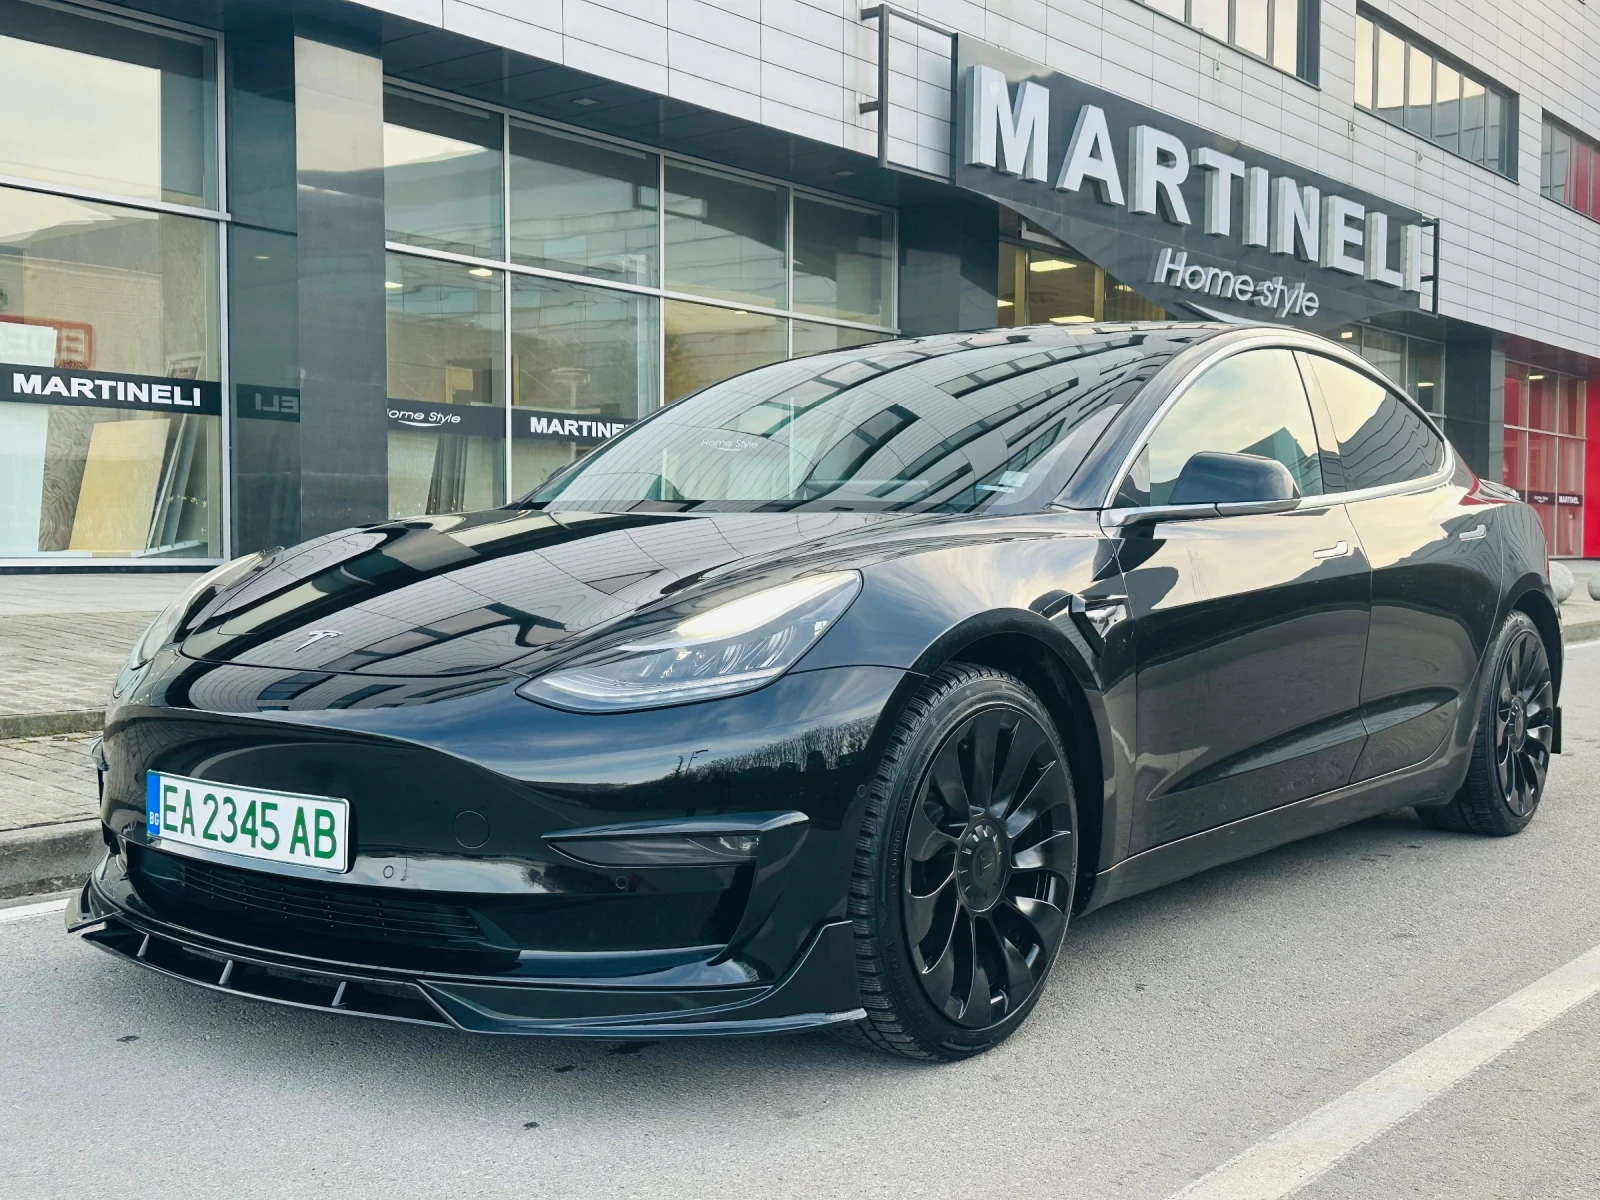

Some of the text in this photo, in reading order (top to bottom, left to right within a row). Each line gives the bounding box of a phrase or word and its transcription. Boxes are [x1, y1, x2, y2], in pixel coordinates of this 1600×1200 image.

[965, 64, 1421, 293] MARTINELI
[1154, 248, 1254, 301] Home
[13, 372, 201, 407] MARTINELI
[387, 408, 461, 424] ome Style
[530, 416, 629, 439] MARTINE
[149, 811, 160, 826] BG
[163, 784, 337, 859] EA 2345 AB
